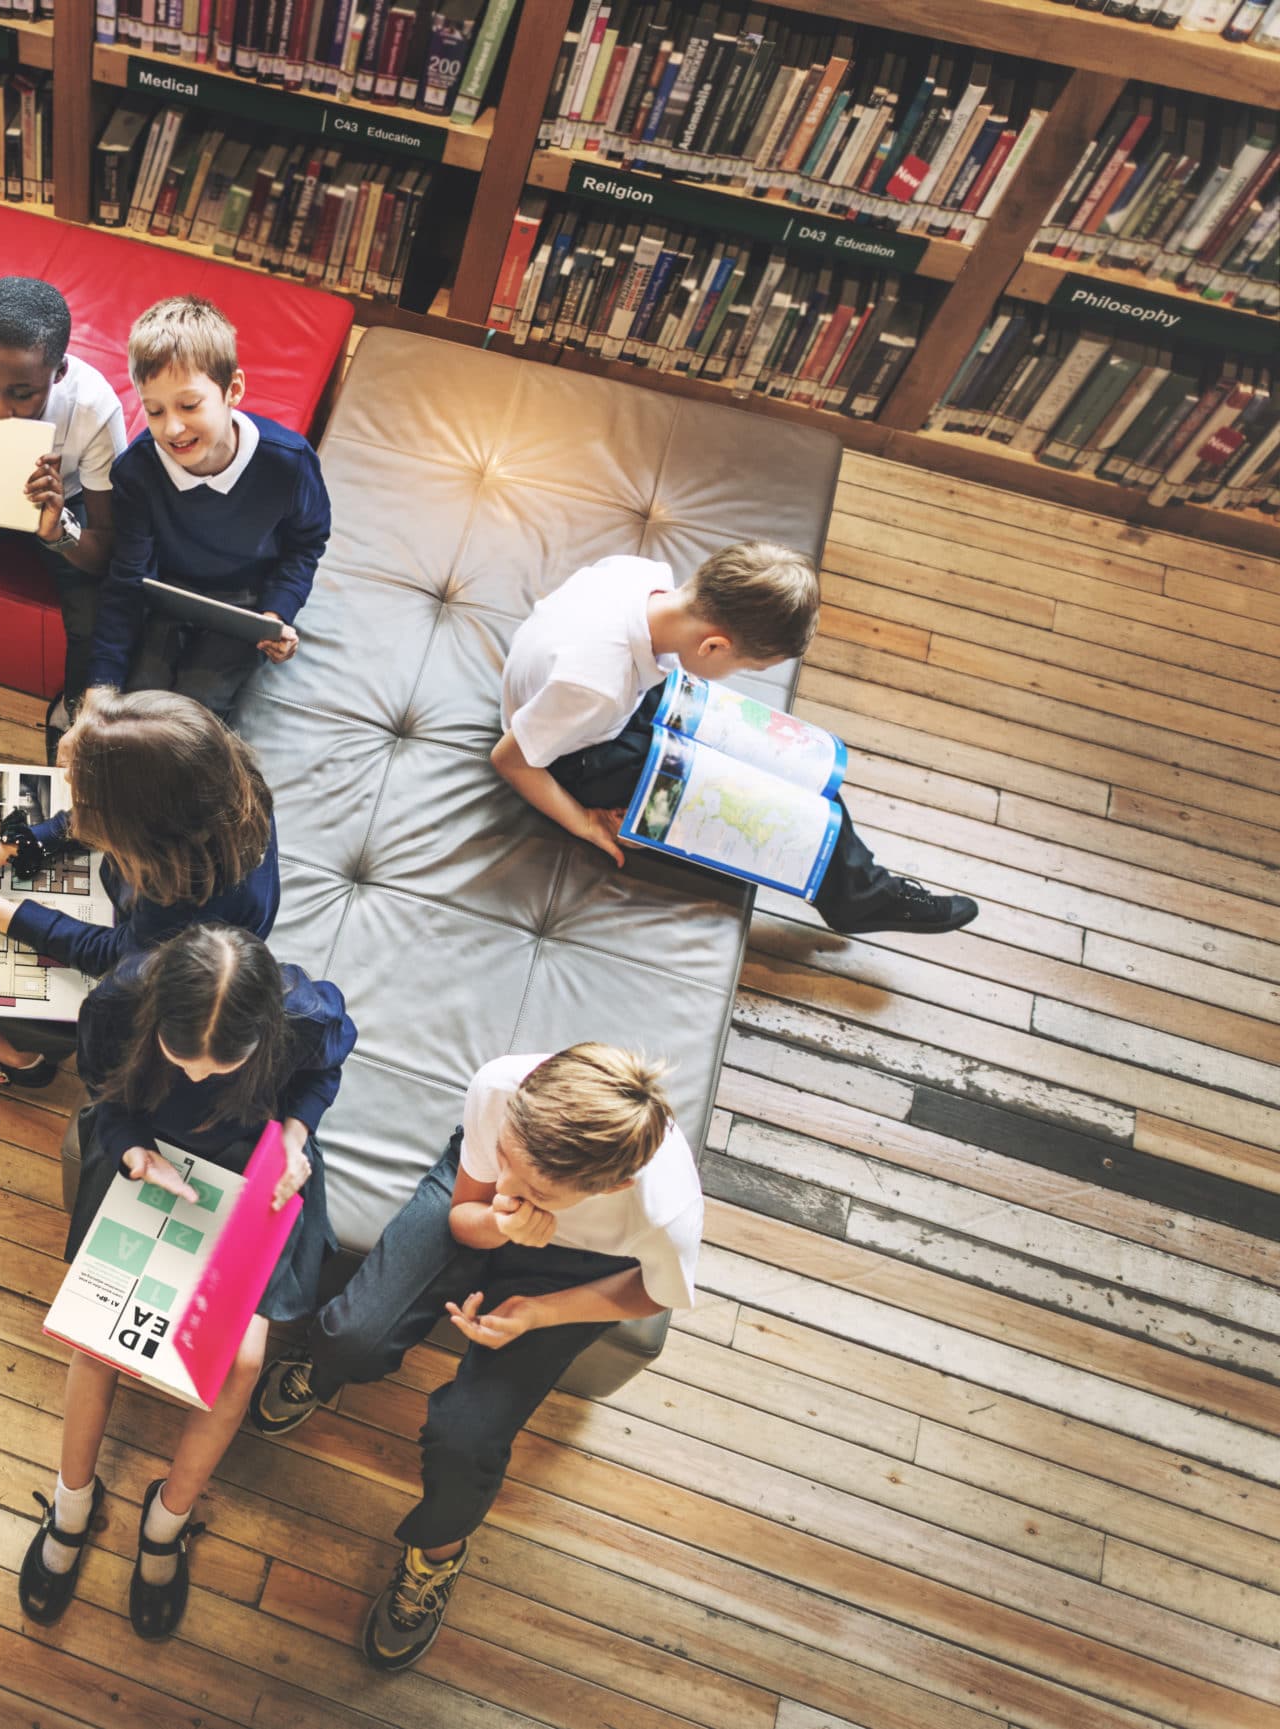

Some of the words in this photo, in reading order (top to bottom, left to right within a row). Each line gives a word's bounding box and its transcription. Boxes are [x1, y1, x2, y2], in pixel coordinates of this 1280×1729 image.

[428, 55, 461, 76] 200
[139, 71, 199, 96] Medical
[678, 82, 713, 150] Automobile
[334, 118, 359, 134] C43
[367, 125, 422, 148] Education
[894, 164, 921, 189] New
[582, 176, 654, 205] Religion
[798, 226, 827, 242] D43
[834, 236, 897, 259] Education
[1071, 290, 1182, 327] Philosophy
[1208, 434, 1234, 455] New
[118, 1233, 144, 1261] A
[175, 1226, 194, 1246] 2
[150, 1282, 163, 1301] 1
